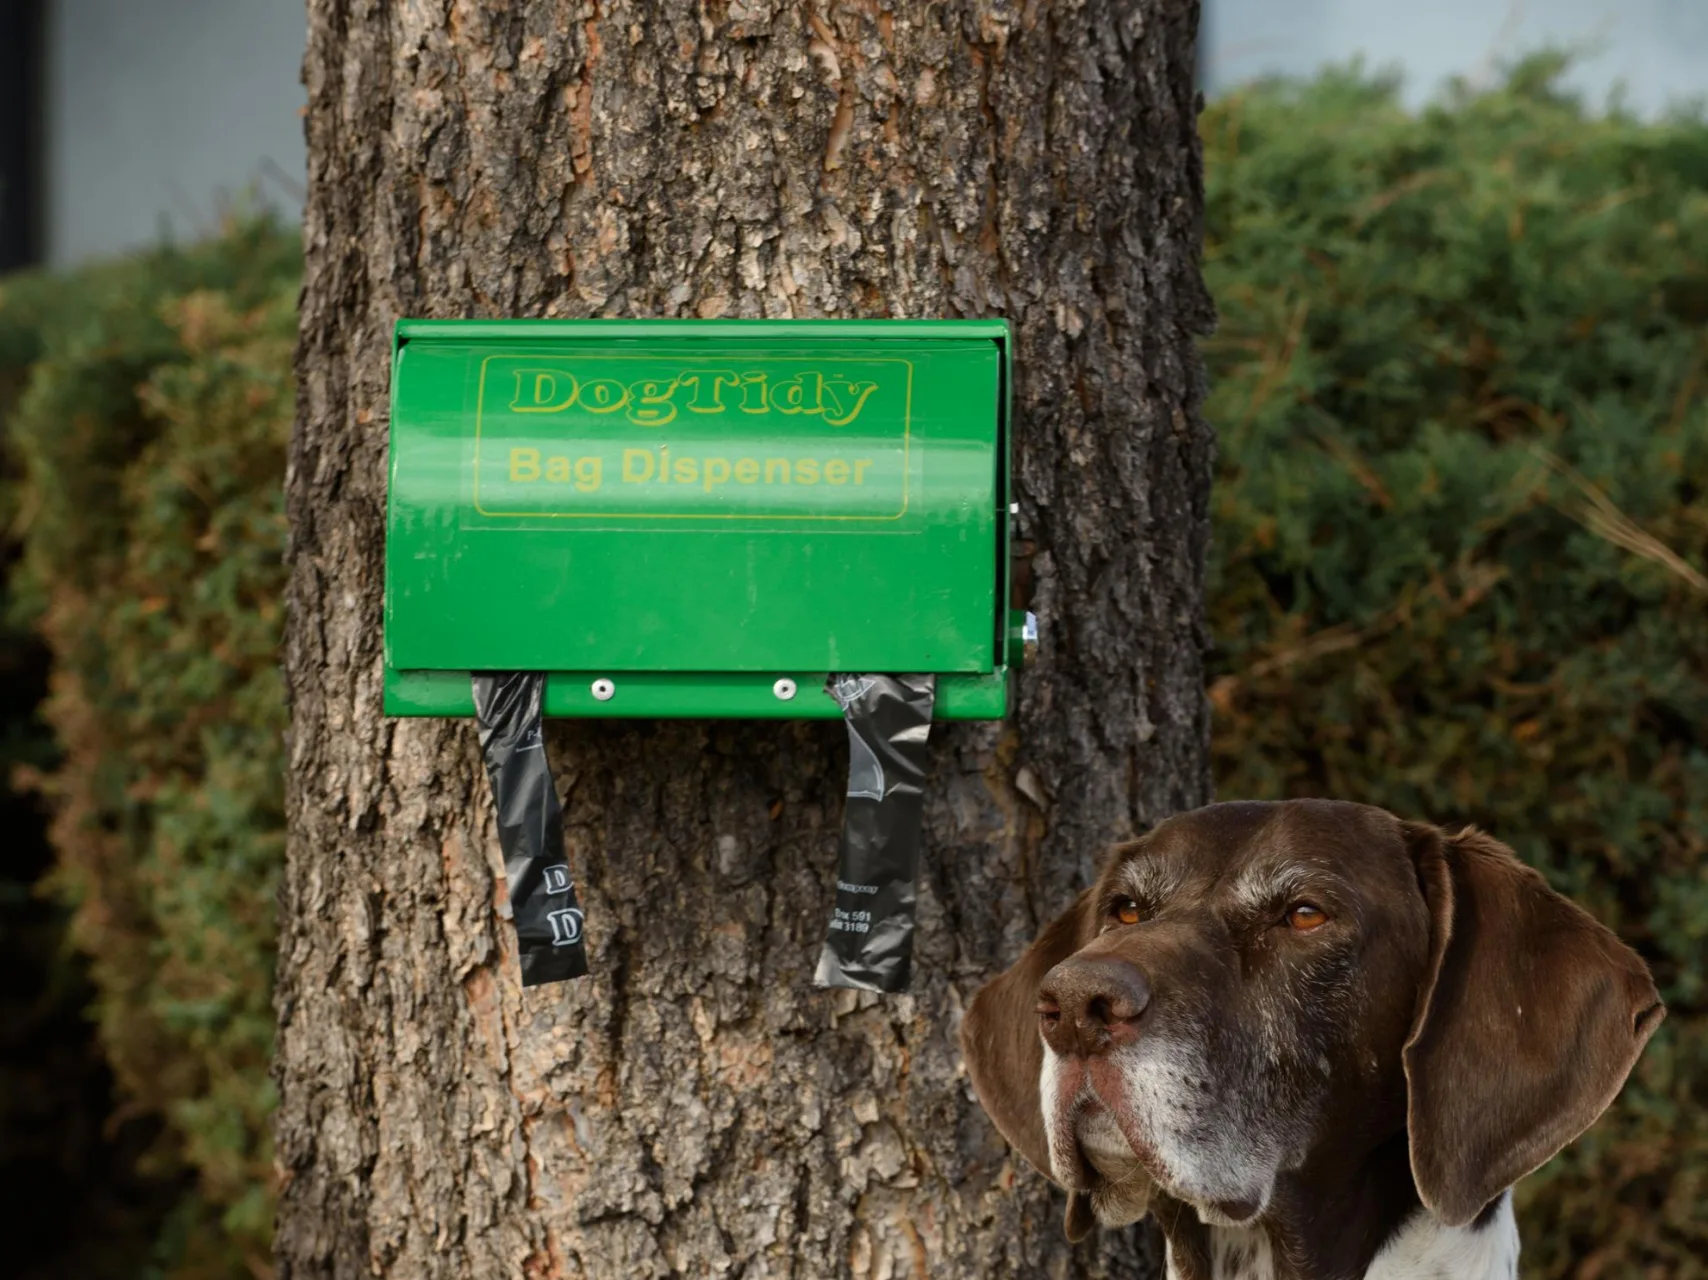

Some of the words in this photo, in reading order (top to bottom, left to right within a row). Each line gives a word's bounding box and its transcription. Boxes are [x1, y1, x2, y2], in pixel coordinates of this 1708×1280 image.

[509, 367, 879, 426] DogTidy
[509, 447, 603, 491] Bag
[621, 446, 873, 493] Dispenser
[852, 910, 871, 922] 591
